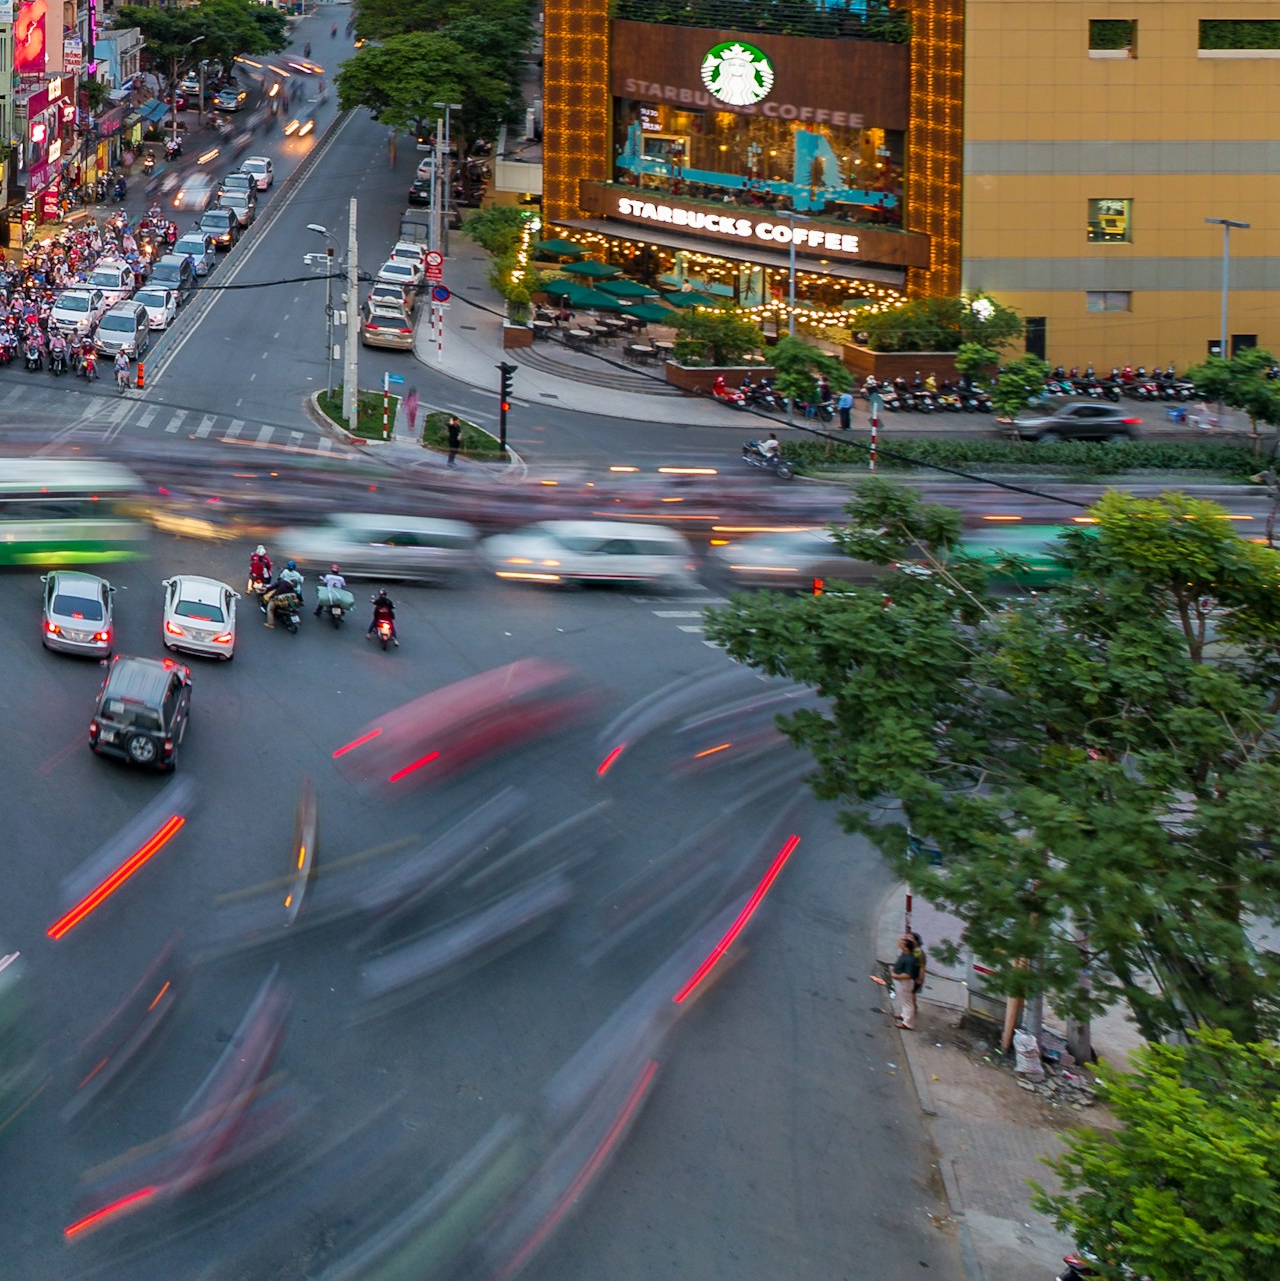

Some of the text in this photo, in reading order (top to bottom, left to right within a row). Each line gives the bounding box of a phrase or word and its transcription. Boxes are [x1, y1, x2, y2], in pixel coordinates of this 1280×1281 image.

[763, 101, 865, 128] COFFEE
[618, 198, 859, 253] STARBUCKS COFFEE
